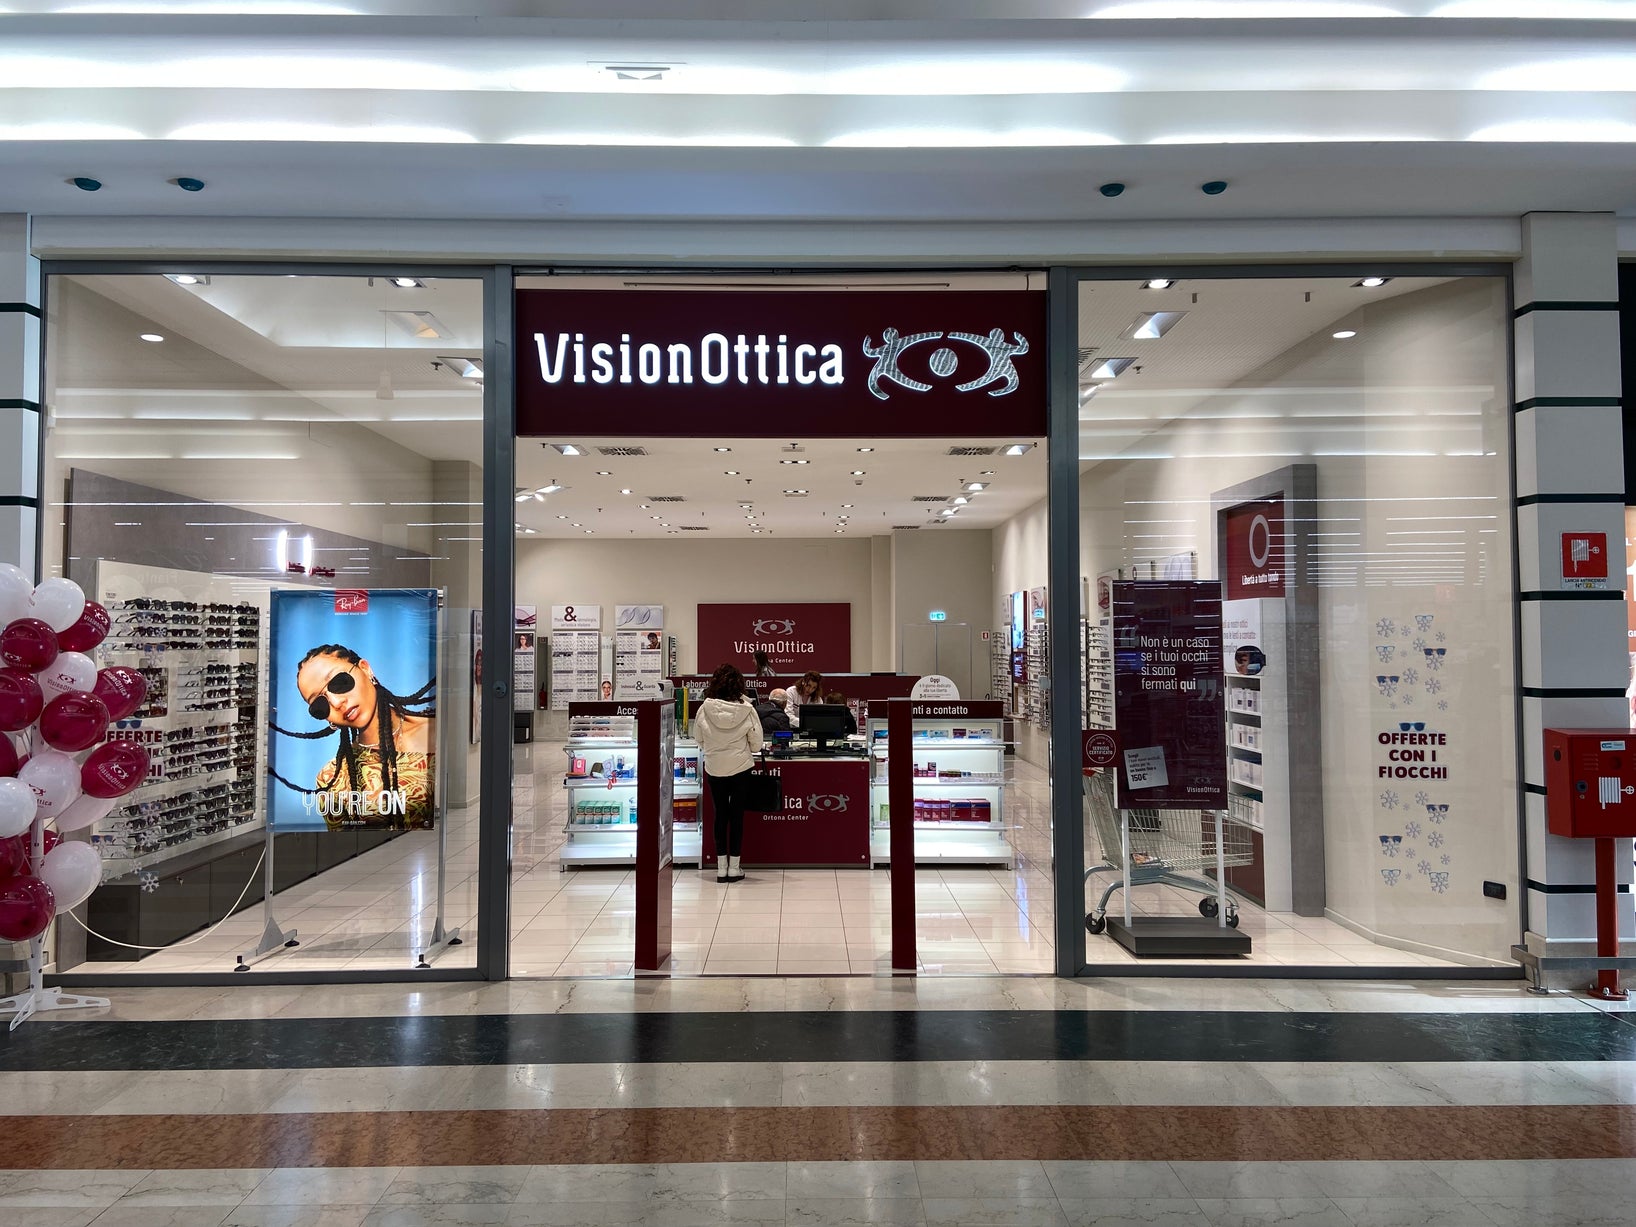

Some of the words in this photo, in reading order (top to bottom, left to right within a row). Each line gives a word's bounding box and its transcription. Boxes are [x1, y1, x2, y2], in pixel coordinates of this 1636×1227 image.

[533, 332, 846, 386] VisionOttica
[336, 594, 366, 610] Ray-Ban
[734, 640, 814, 653] VisionOttica
[1141, 636, 1160, 648] Non
[1163, 636, 1169, 648] è
[1172, 639, 1184, 648] un
[1186, 639, 1210, 648] caso
[1141, 653, 1152, 662] se
[1155, 650, 1158, 662] i
[1161, 650, 1179, 662] tuoi
[1182, 650, 1208, 662] occhi
[1142, 664, 1150, 676] si
[1152, 667, 1176, 676] sono
[682, 680, 710, 688] Laborat
[1142, 678, 1178, 690] fermati
[1180, 678, 1196, 693] qui
[617, 706, 638, 716] Acce
[912, 705, 924, 715] nti
[926, 707, 932, 715] a
[933, 706, 968, 715] contatto
[103, 730, 162, 743] FFERTE
[1378, 733, 1446, 746] OFFERTE
[1389, 750, 1425, 762] CON
[1432, 750, 1436, 762] I
[1379, 766, 1447, 779] FIOCCHI
[302, 790, 374, 816] YOU'RE
[378, 790, 406, 816] ON
